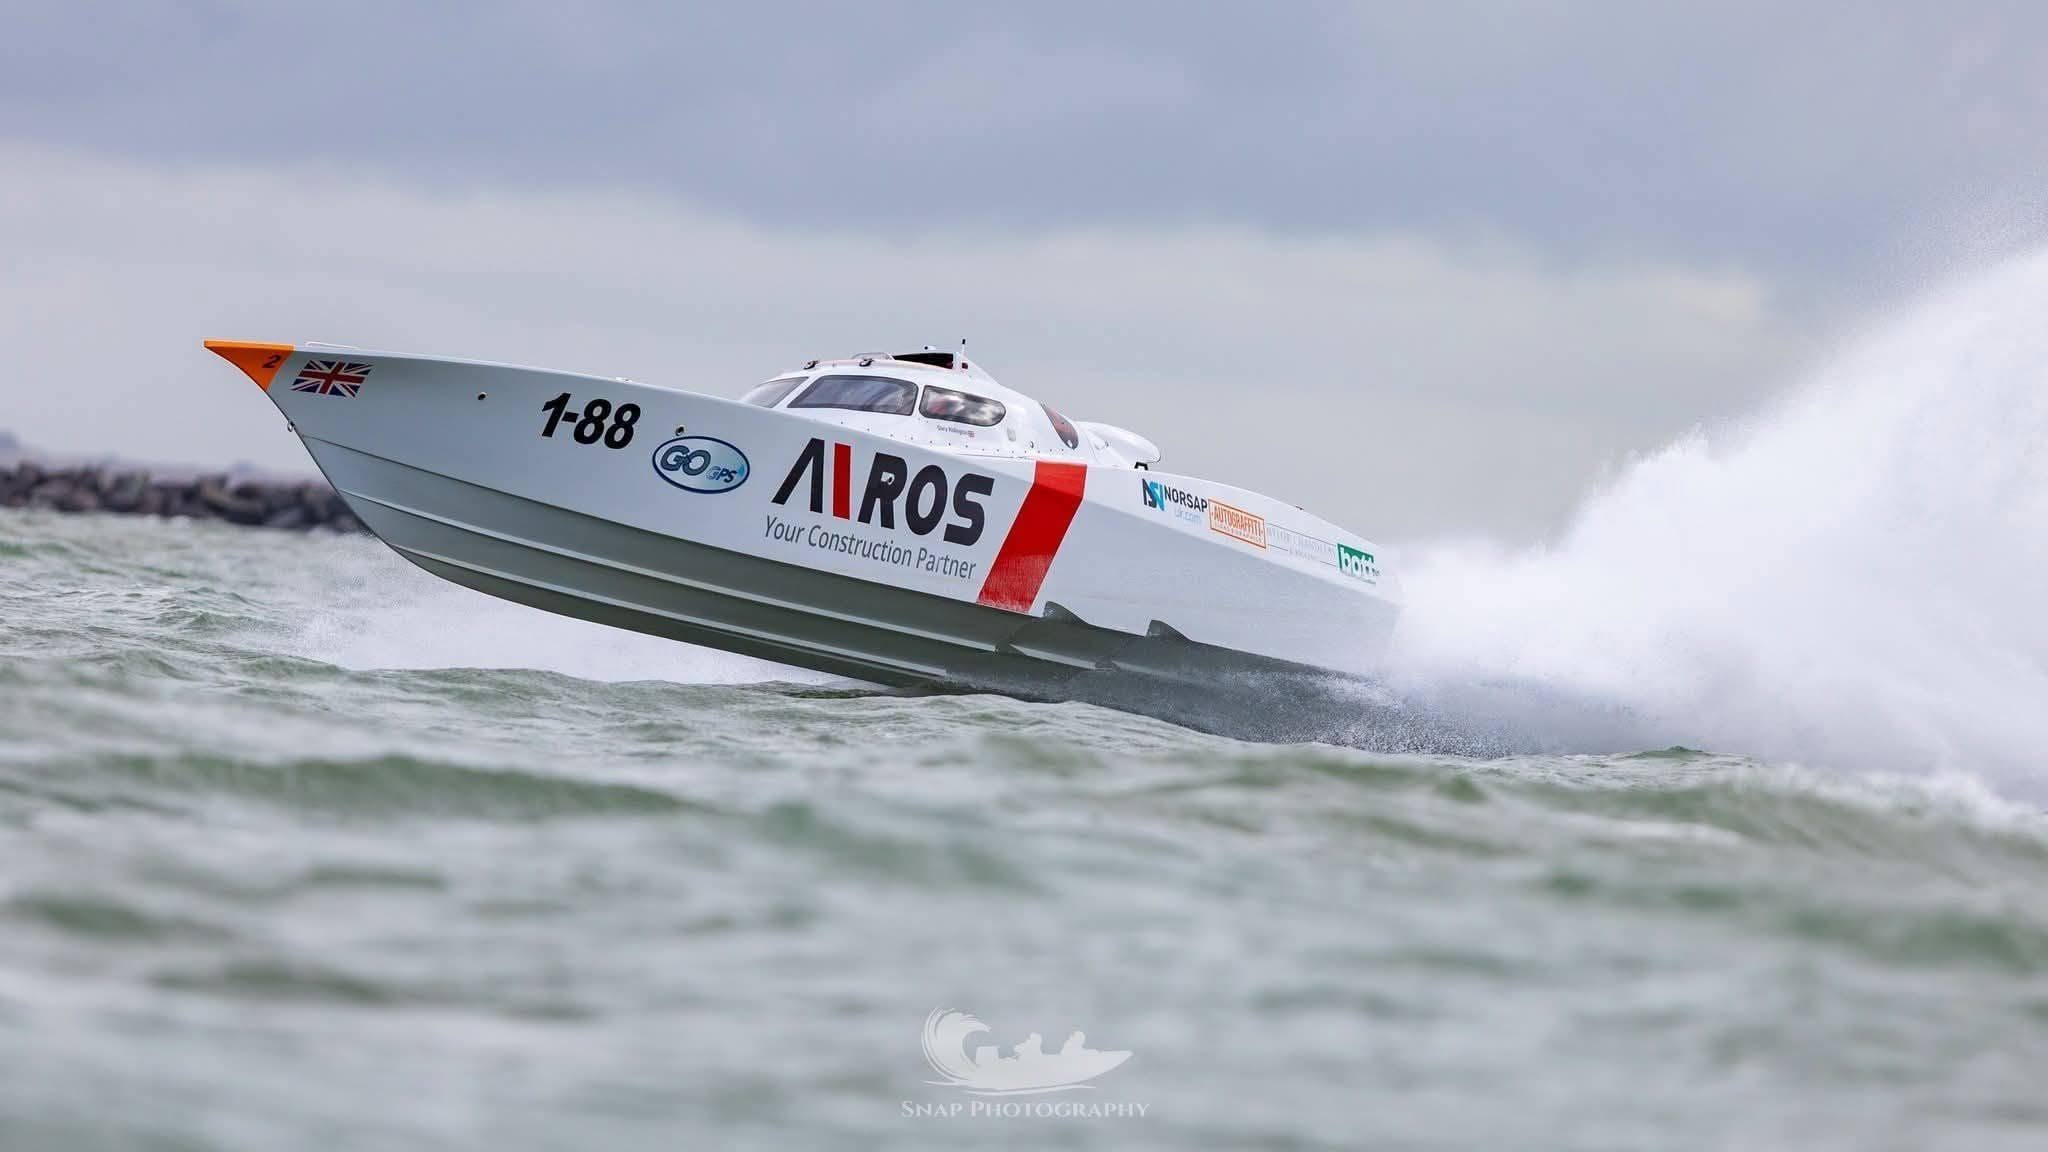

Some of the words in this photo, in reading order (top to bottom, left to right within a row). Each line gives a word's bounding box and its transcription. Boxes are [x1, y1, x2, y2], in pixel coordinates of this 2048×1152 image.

[262, 355, 281, 368] 2
[541, 392, 641, 449] 1-88
[660, 444, 712, 476] GO
[705, 465, 738, 483] GPS
[771, 437, 995, 547] AIROS
[1164, 484, 1208, 513] NORSAP
[764, 514, 805, 546] Your
[808, 524, 913, 567] Construction
[916, 546, 977, 580] Partner
